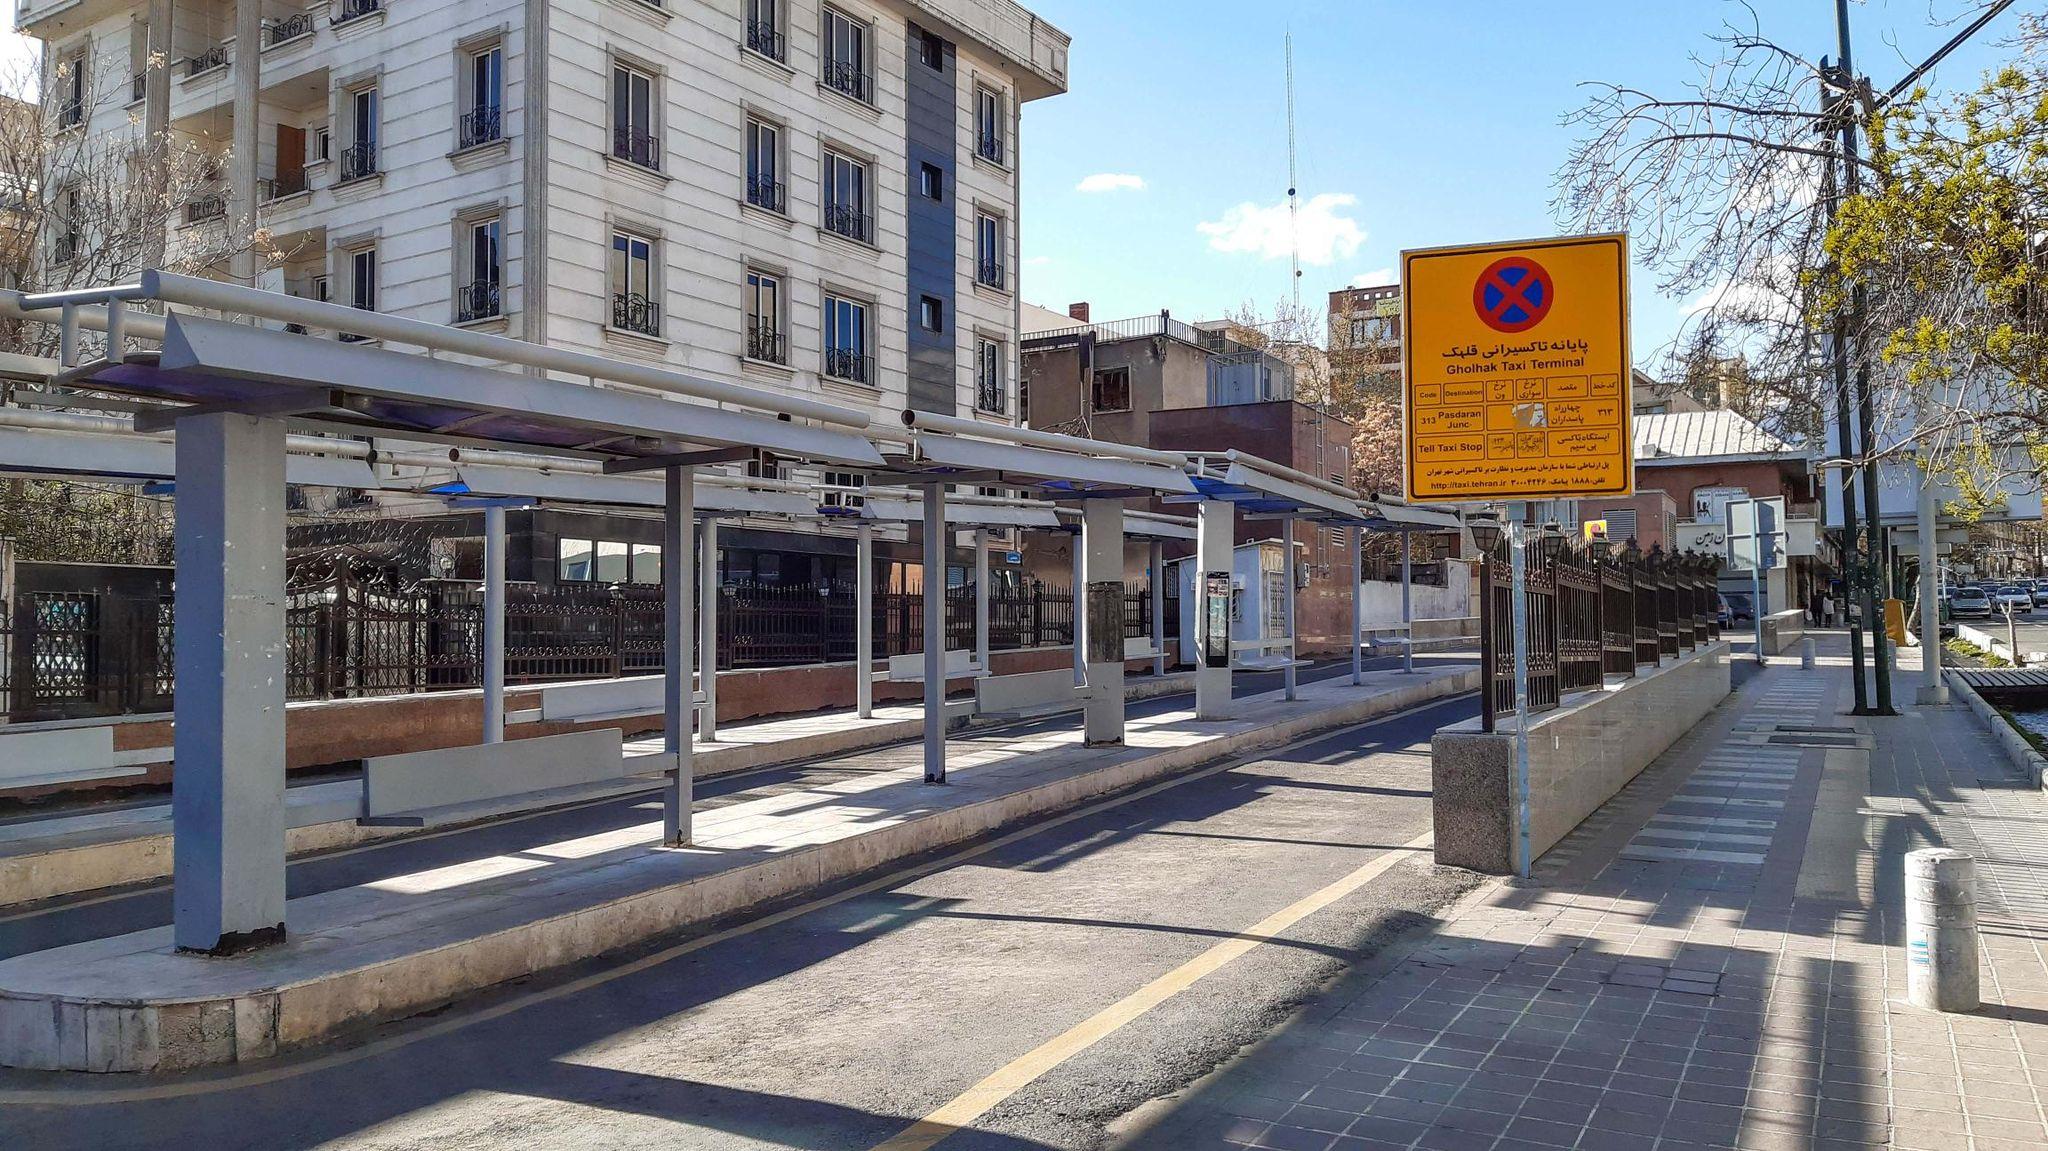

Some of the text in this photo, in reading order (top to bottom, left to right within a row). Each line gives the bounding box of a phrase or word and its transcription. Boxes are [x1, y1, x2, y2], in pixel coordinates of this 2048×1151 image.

[1442, 339, 1588, 359] پایانه تاکسیرانی قلهک
[1446, 357, 1584, 374] Gholhak Taxi Terminal
[1494, 380, 1506, 390] نرخ
[1524, 379, 1536, 390] نرخ
[1520, 390, 1541, 399] سواری
[1554, 404, 1580, 413] چهارراه
[1438, 411, 1481, 419] Pasdaran
[1421, 416, 1436, 424] 313
[1551, 415, 1584, 425] پاسداران
[1558, 433, 1610, 444] ایستگاه تاکسی
[1418, 444, 1435, 453] Tell
[1437, 444, 1457, 452] Taxi
[1460, 442, 1482, 452] Stop
[1570, 444, 1597, 452] بی سیم
[1492, 464, 1509, 472] نظارت
[1538, 464, 1558, 472] سازمان
[1578, 462, 1600, 471] ارتباطی
[1602, 462, 1610, 470] پل
[1426, 468, 1442, 476] تهران
[1454, 466, 1482, 476] تاکسیرانی
[1430, 480, 1507, 490] http://taxi.tehran.ir
